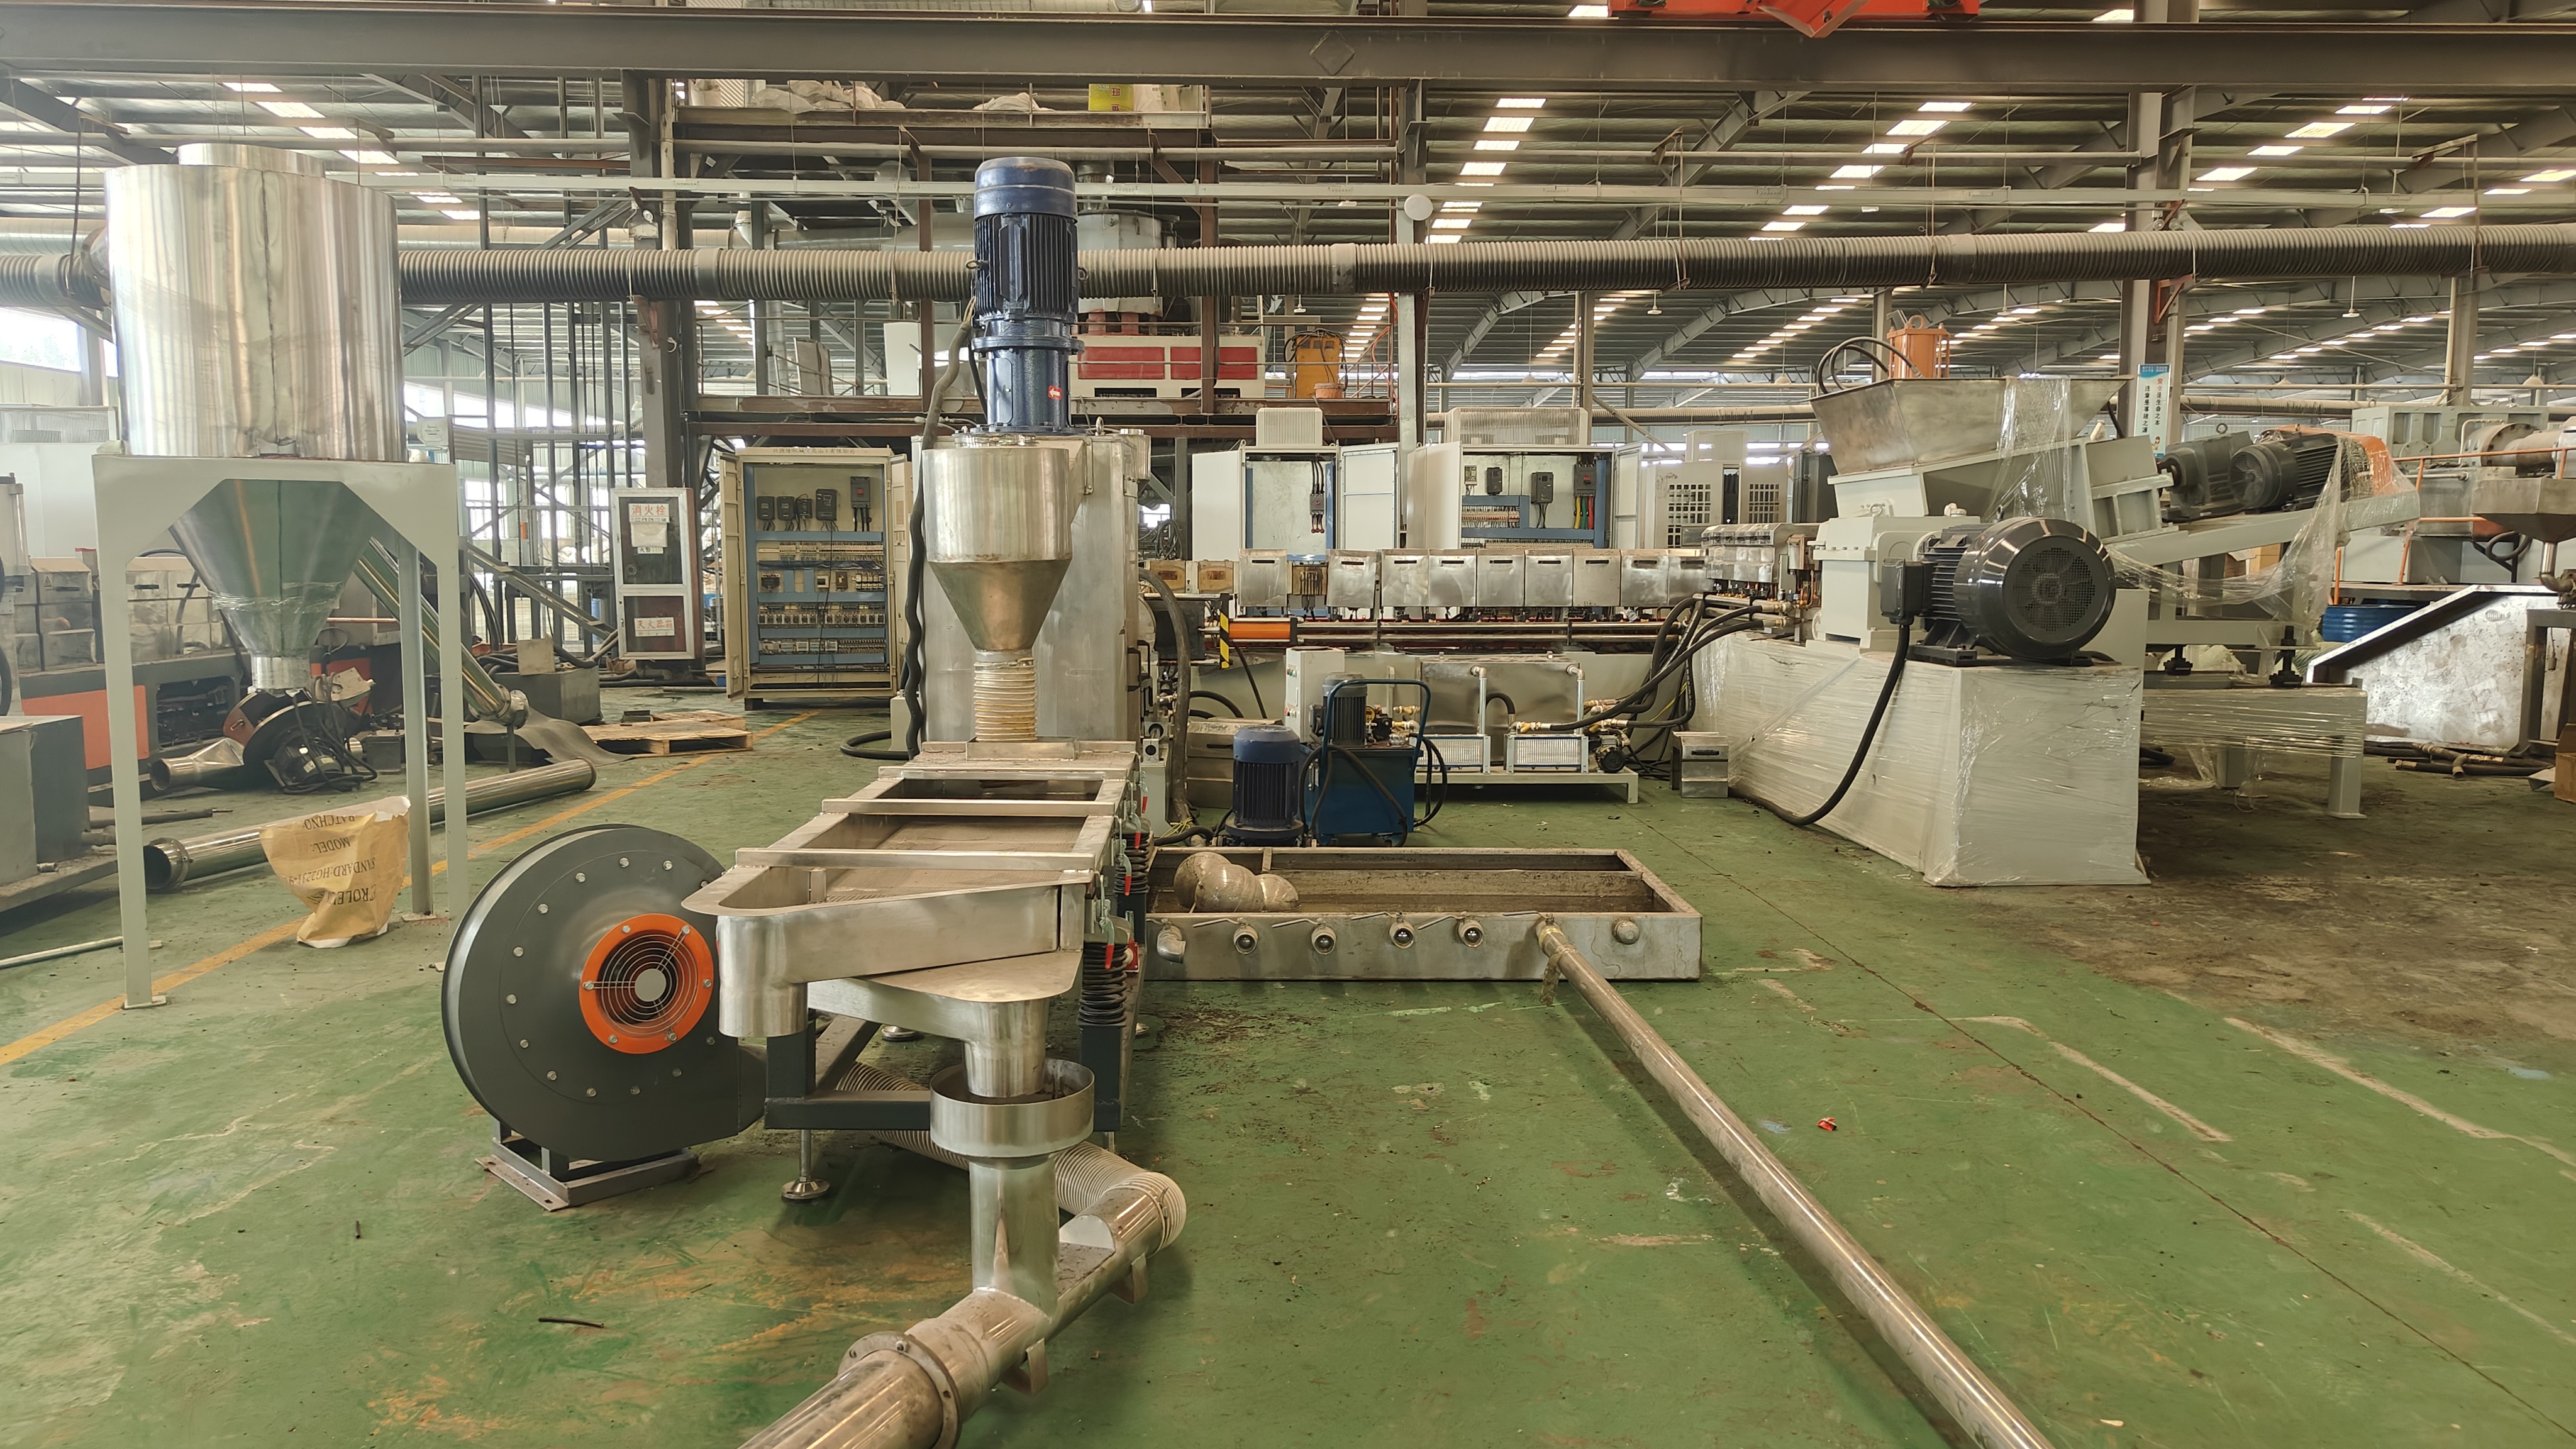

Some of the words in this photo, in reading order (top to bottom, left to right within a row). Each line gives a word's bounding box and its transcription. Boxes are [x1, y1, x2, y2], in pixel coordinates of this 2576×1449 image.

[631, 504, 666, 516] 消火栓
[310, 837, 352, 854] MODEL:
